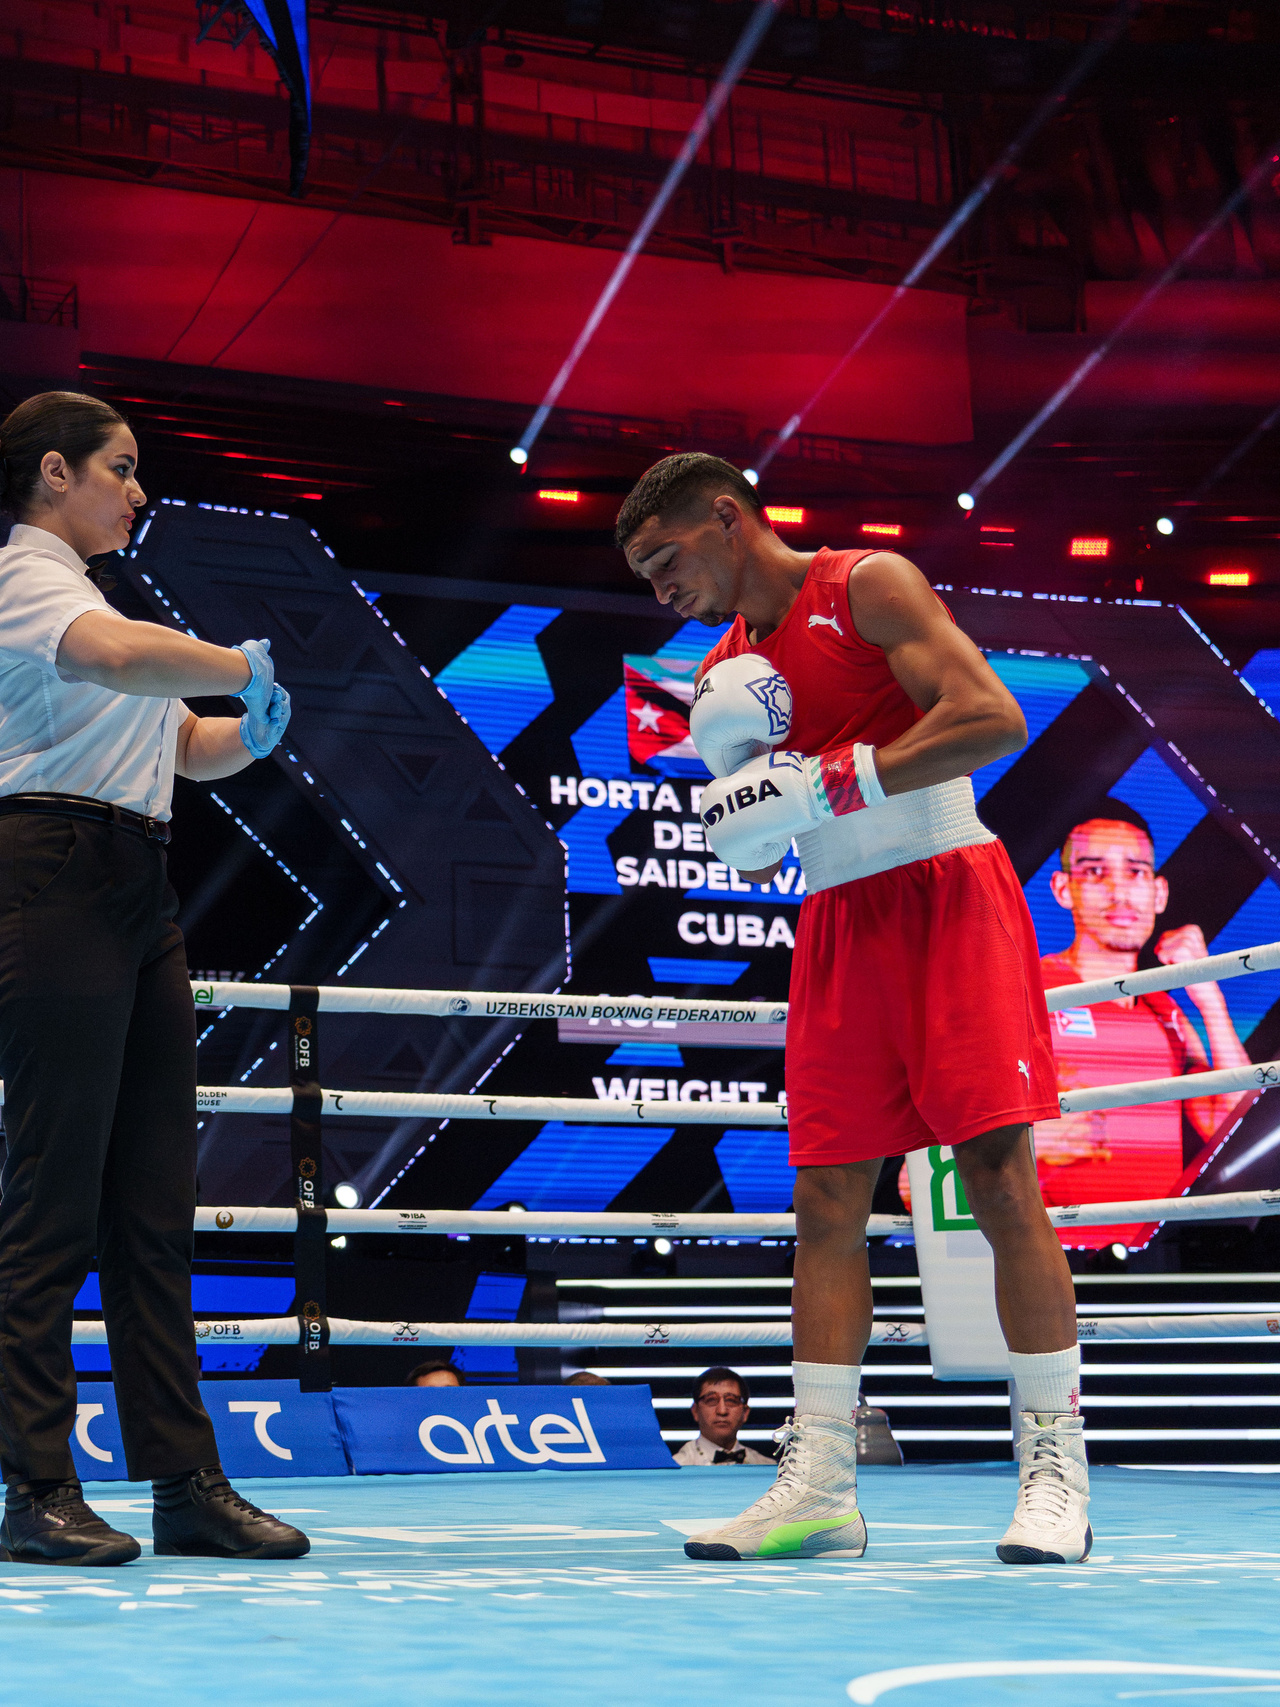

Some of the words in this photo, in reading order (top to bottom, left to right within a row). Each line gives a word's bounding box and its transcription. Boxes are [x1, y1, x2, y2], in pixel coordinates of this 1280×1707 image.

[550, 775, 683, 812] HORTA
[726, 778, 783, 815] IBA
[653, 820, 713, 852] DE
[616, 856, 752, 892] SAIDEL
[677, 911, 795, 949] CUBA
[486, 1001, 587, 1018] UZBEKISTAN
[591, 1005, 654, 1020] BOXING
[656, 1006, 757, 1023] FEDERATION
[299, 1038, 310, 1068] OFB
[197, 1099, 221, 1107] OUSE
[592, 1076, 767, 1102] WEIGHT
[303, 1180, 315, 1209] OFB
[213, 1324, 241, 1335] OFB
[309, 1322, 321, 1350] OFB
[419, 1397, 606, 1465] artel
[148, 1563, 799, 1582] WORLD
